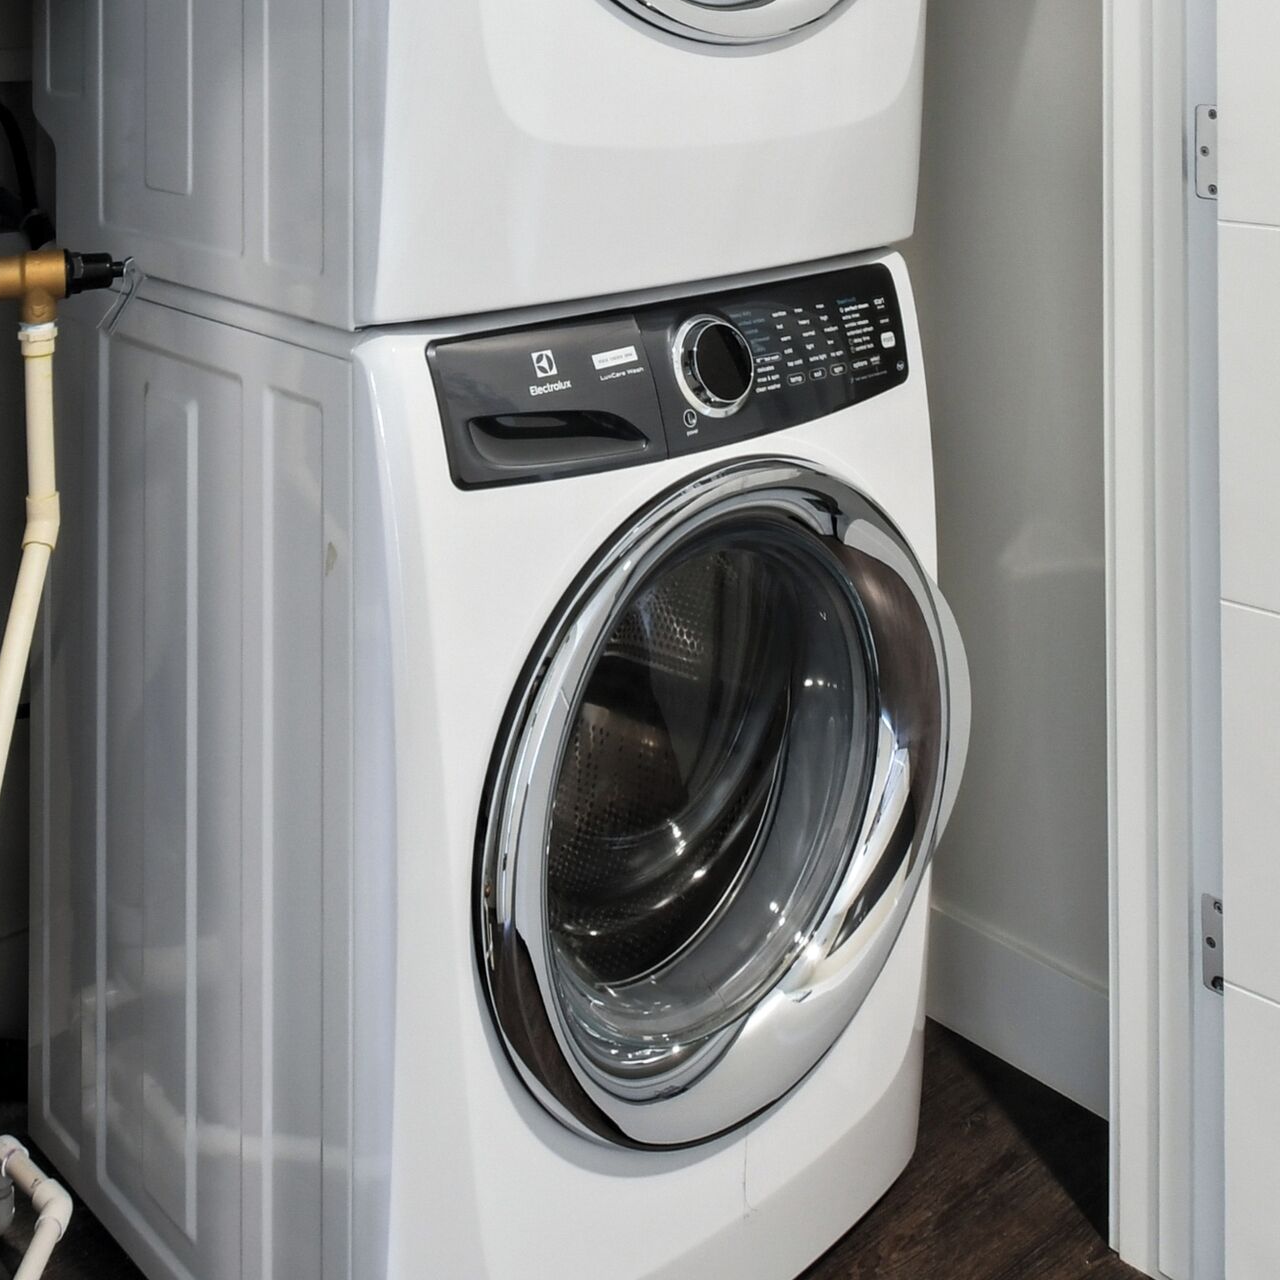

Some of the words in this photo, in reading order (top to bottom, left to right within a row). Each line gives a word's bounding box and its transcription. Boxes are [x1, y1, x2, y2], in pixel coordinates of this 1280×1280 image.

[599, 369, 627, 382] LuxCare
[627, 366, 645, 376] Wash
[528, 379, 573, 397] Electrolux
